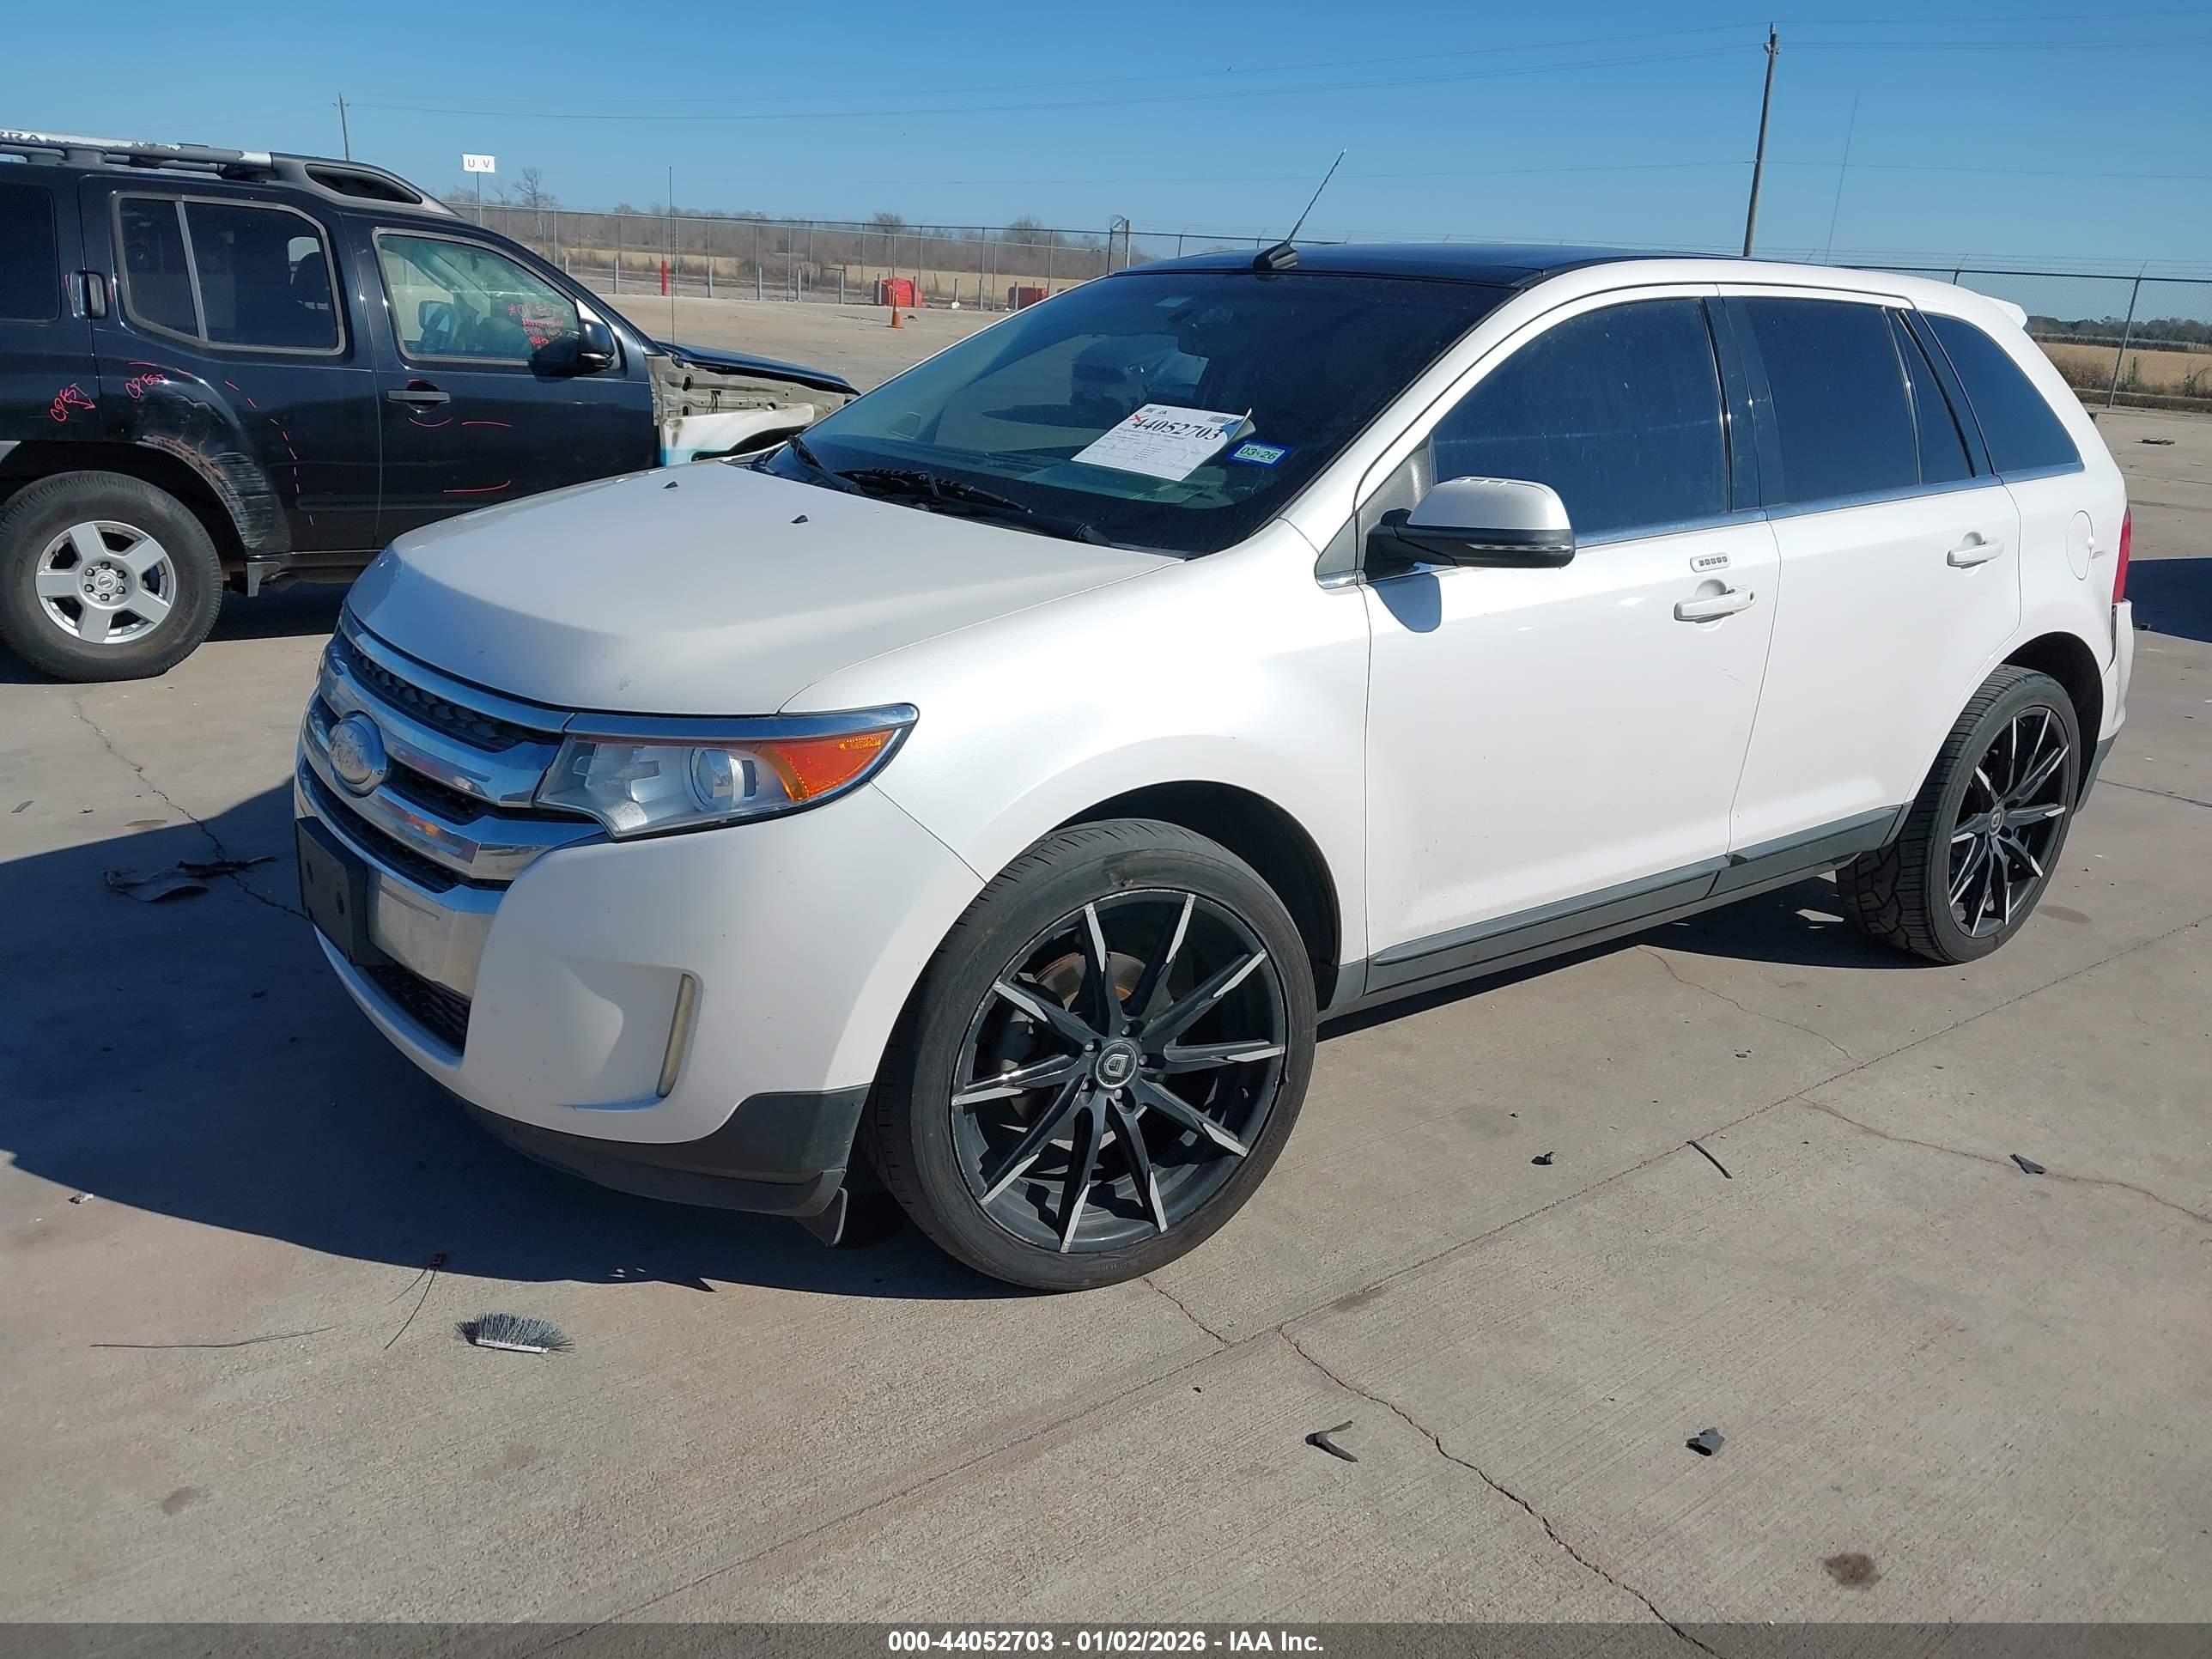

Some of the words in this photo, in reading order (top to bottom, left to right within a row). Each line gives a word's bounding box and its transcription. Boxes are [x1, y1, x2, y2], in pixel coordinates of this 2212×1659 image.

[467, 158, 476, 168] U
[483, 159, 490, 168] V
[1132, 418, 1224, 441] 44052703
[1240, 447, 1258, 456] 03
[1259, 451, 1279, 460] 26
